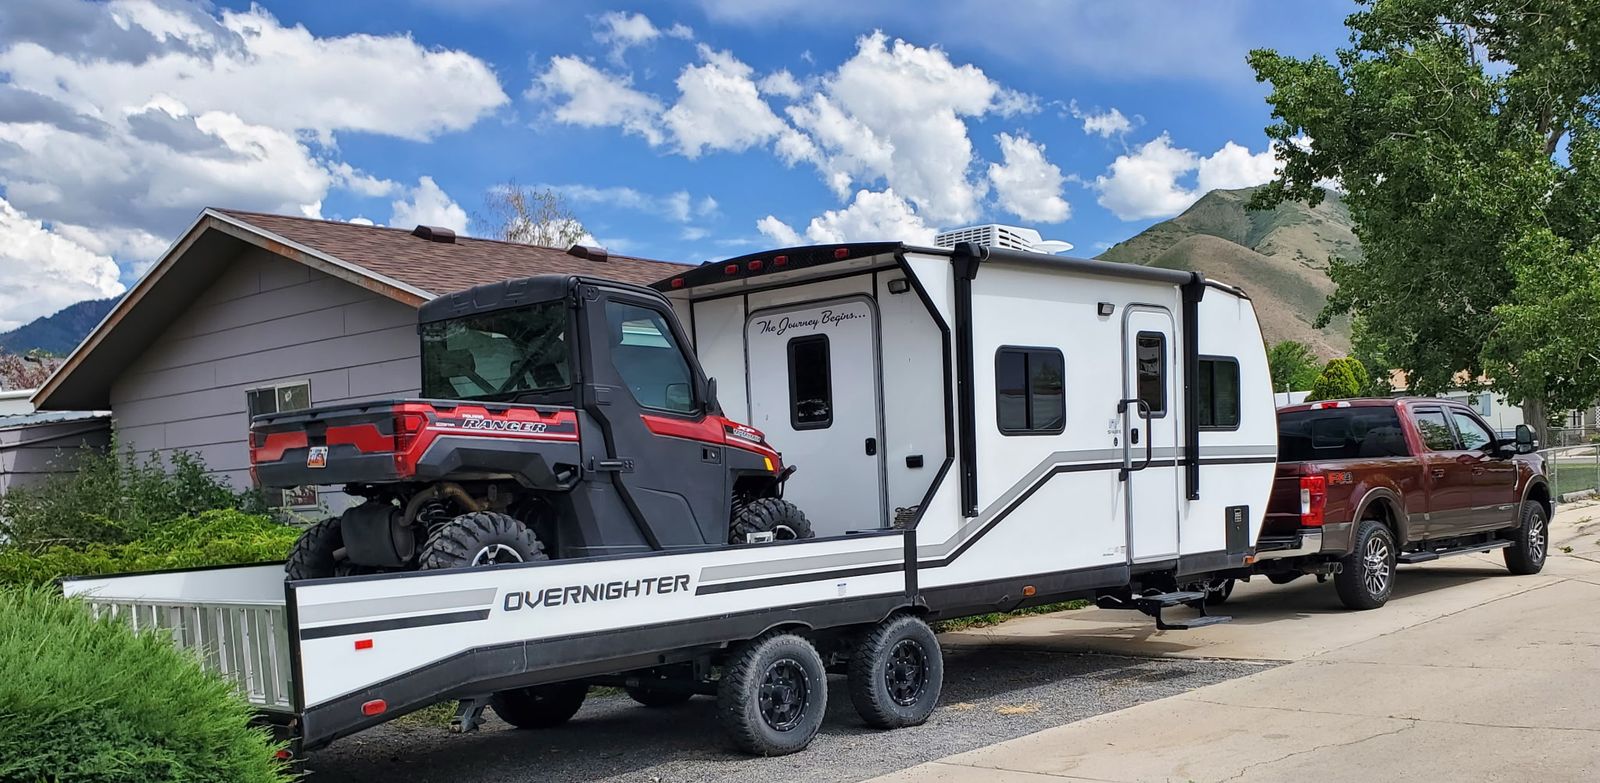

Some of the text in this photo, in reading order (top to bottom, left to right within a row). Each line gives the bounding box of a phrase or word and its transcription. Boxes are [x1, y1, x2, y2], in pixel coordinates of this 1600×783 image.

[757, 310, 866, 335] The Journey Begins...
[462, 418, 547, 433] RANGER
[503, 574, 691, 612] OVERNIGHTER
